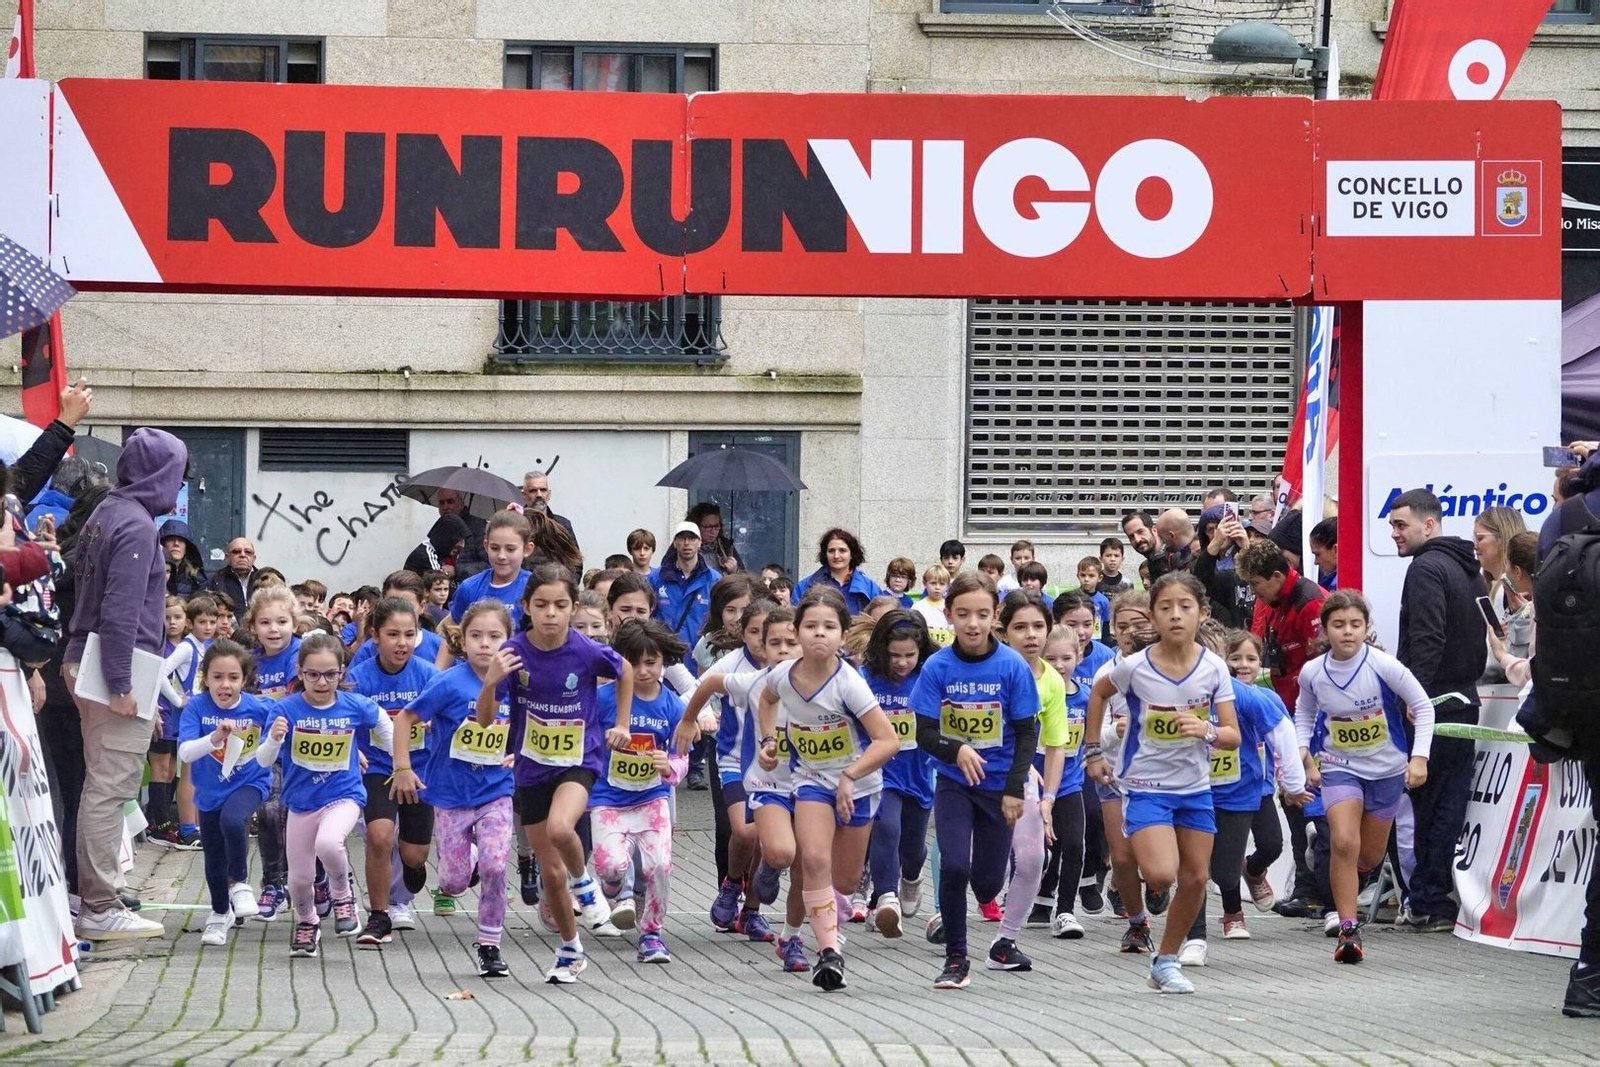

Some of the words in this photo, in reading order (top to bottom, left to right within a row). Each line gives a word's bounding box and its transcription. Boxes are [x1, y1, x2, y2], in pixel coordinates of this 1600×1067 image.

[1337, 177, 1463, 195] CONCELLO
[1352, 201, 1383, 219] DE
[1391, 201, 1448, 219] VIGO
[1561, 217, 1573, 230] lo
[1576, 217, 1600, 230] Mis
[1378, 482, 1548, 519] Aántico
[946, 682, 968, 694] máis
[977, 683, 1001, 696] auga
[527, 701, 549, 711] CHANS
[549, 702, 582, 714] BEMBRIVE
[875, 693, 886, 704] áis
[892, 695, 908, 707] aug
[297, 716, 320, 728] máis
[328, 717, 351, 729] auga
[646, 717, 669, 730] auga
[949, 713, 994, 734] 8029
[461, 729, 504, 749] 8109
[531, 729, 574, 751] 8015
[1337, 724, 1381, 743] 8082
[299, 740, 345, 757] 8097
[798, 736, 844, 755] 8046
[1211, 756, 1232, 773] 75
